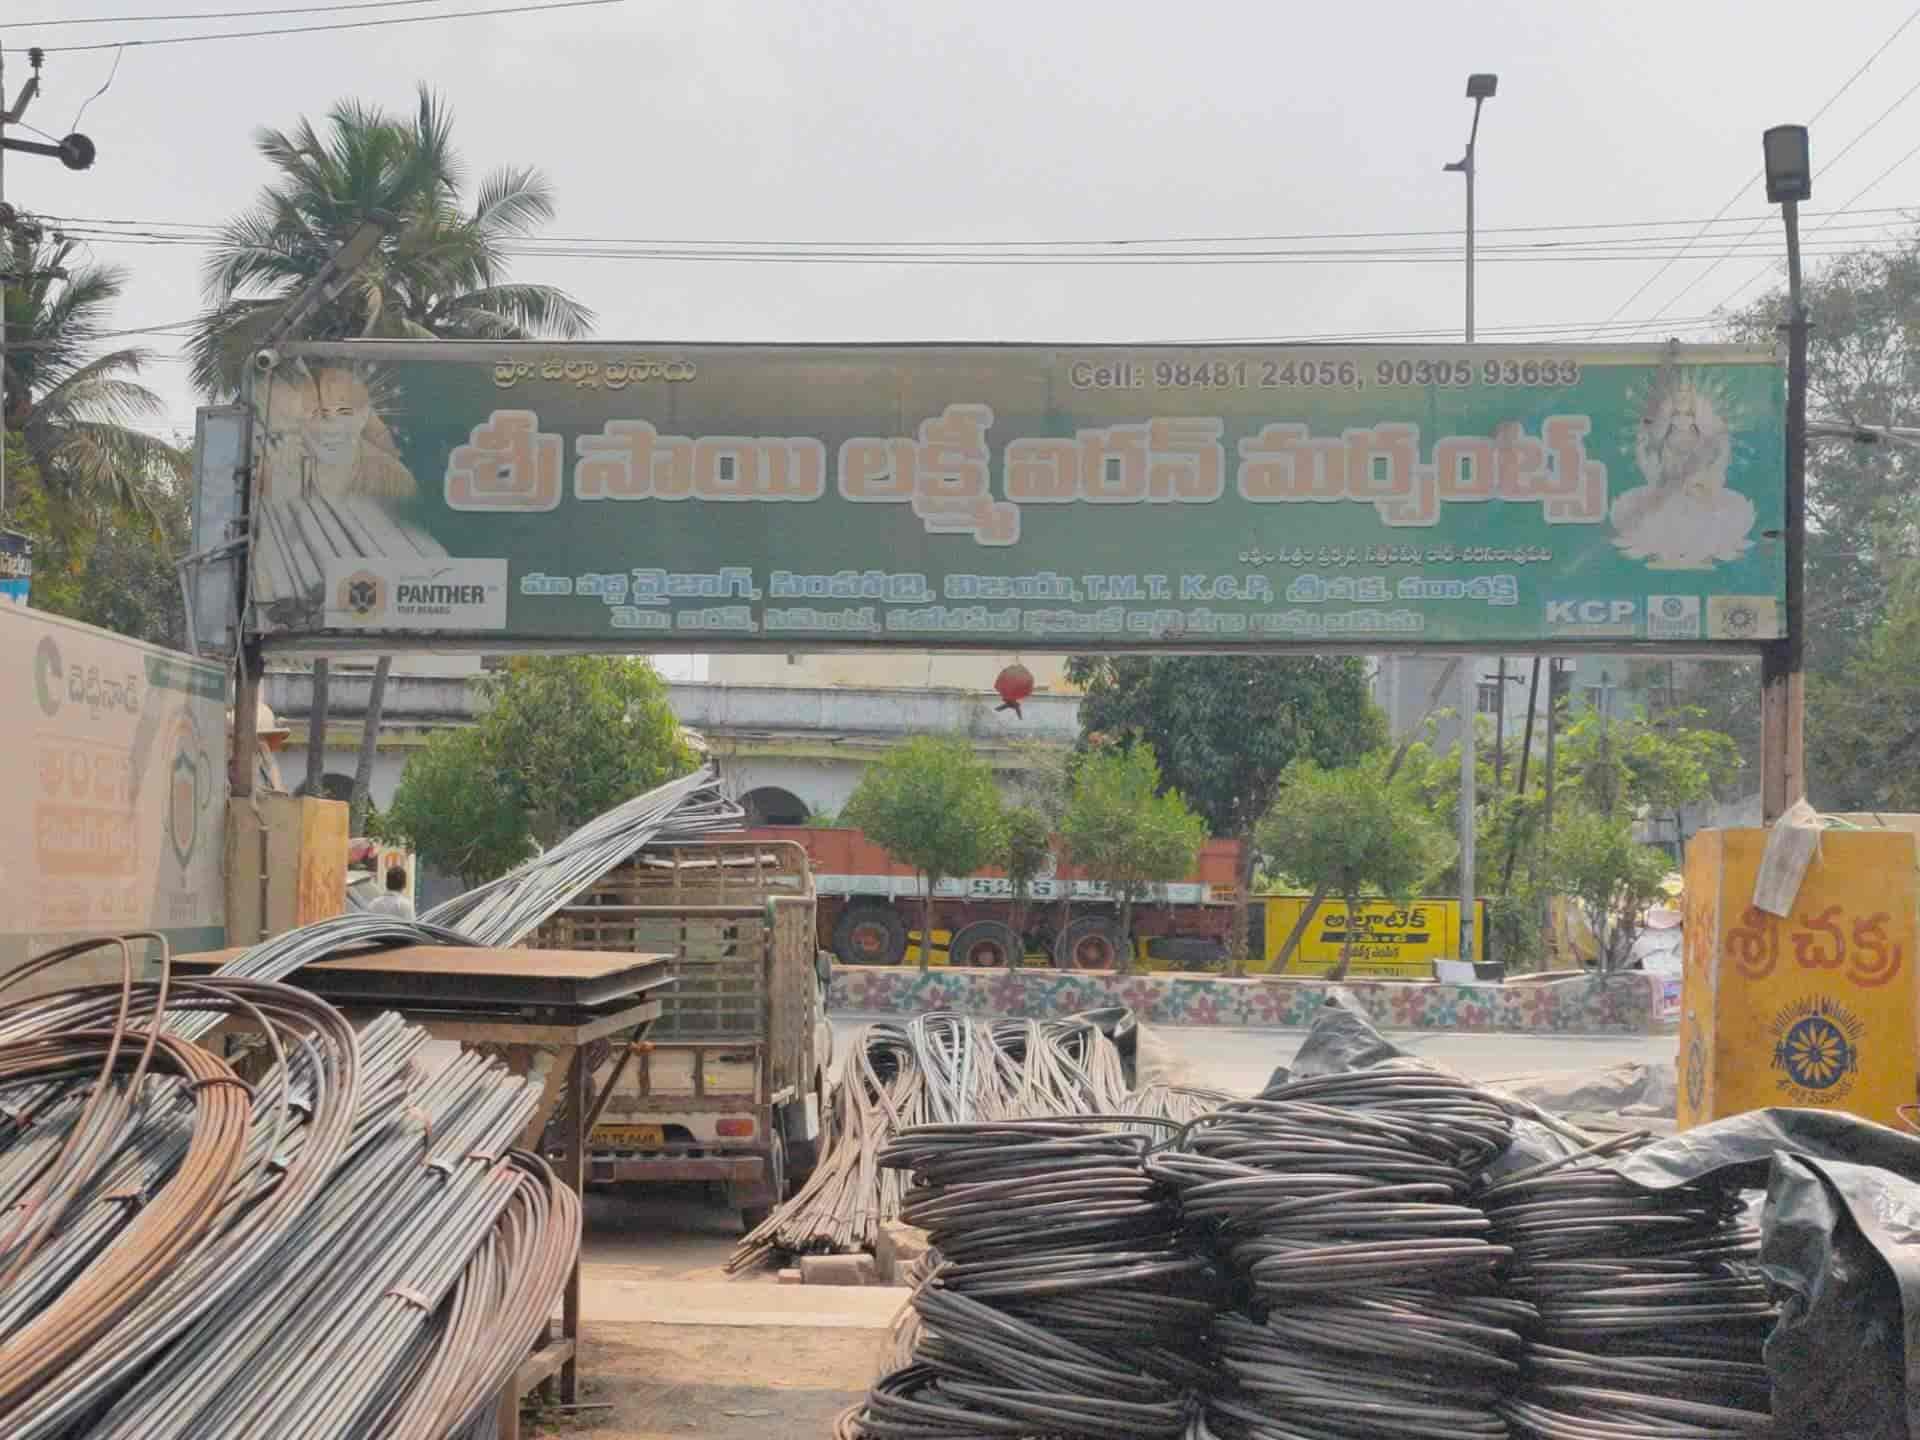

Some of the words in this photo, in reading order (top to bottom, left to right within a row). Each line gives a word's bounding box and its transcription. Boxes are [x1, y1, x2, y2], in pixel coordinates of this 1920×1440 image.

[1070, 361, 1144, 388] Cell:
[1155, 361, 1248, 388] 98481
[1261, 361, 1363, 390] 24056,
[1376, 360, 1473, 387] 90305
[1482, 360, 1580, 387] 93633
[444, 409, 564, 512] శ్రీ
[574, 418, 827, 502] సాయి
[1003, 416, 1225, 503] ఐరన్
[396, 584, 485, 605] PANTHER
[1544, 598, 1636, 625] KCP
[1791, 905, 1903, 988] చక్ర
